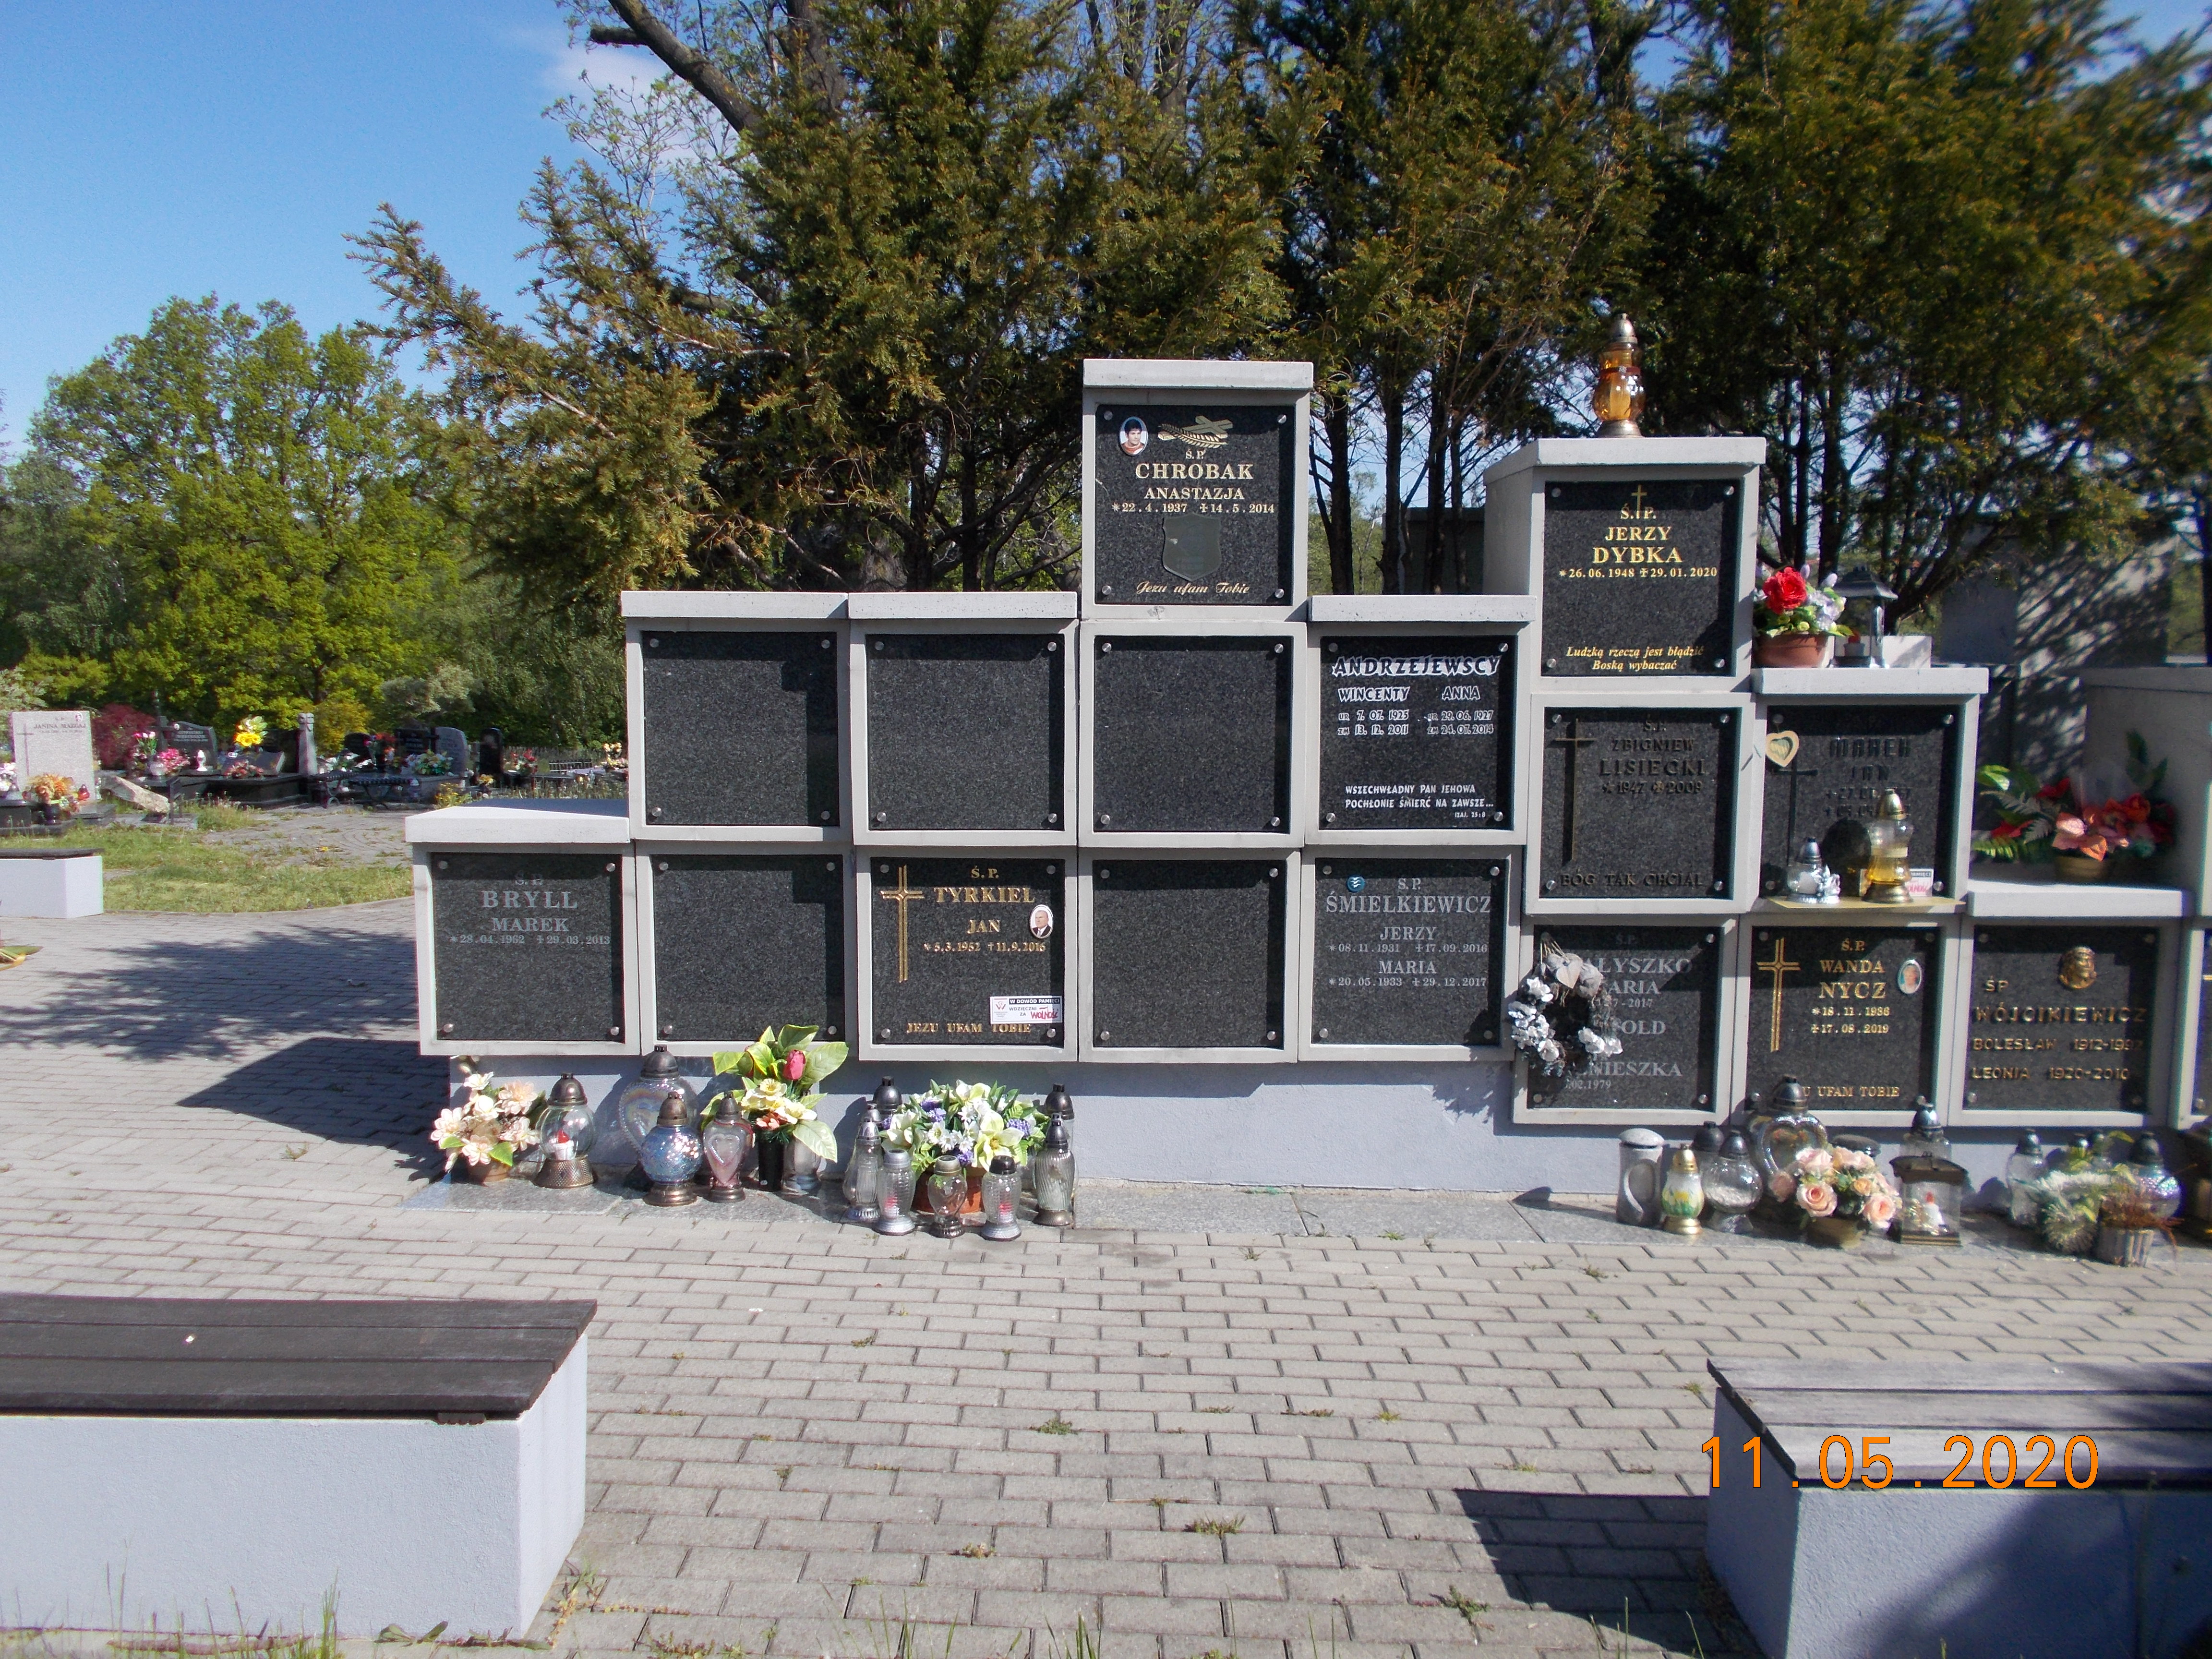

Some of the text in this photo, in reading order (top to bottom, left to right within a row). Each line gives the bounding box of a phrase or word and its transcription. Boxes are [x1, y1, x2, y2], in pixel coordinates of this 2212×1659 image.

[1135, 463, 1254, 480] CHROBAK
[1144, 488, 1244, 500] ANASTAZJA
[1605, 526, 1672, 541] JERZY
[1592, 547, 1683, 564] DYBKA
[1136, 581, 1250, 595] Jezu ufam Tobie
[1566, 646, 1704, 658] Ludzką rzeczą jest błądzić
[1332, 655, 1502, 677] ANDRZEJEWSCY
[1592, 660, 1677, 672] Boską wybaczać
[1337, 686, 1410, 702] WINCENTY
[1442, 685, 1480, 701] ANNA
[1338, 713, 1350, 721] UR
[1427, 713, 1439, 721] UR
[1337, 727, 1349, 735] ZM
[1427, 726, 1439, 734] ZM
[1611, 738, 1695, 752] ZBIGNIEW
[1599, 758, 1706, 777] LISIECKI
[1346, 784, 1476, 794] WSZECHWŁADNY PAN JEHOWA
[1345, 799, 1395, 808] POCHŁONIE
[1399, 796, 1431, 808] ŚMIERĆ
[1436, 799, 1447, 807] NA
[1605, 874, 1636, 887] TAK
[482, 890, 578, 908] BRYLL
[934, 887, 1036, 903] TYRKIEL
[1325, 890, 1491, 913] ŚMIELKIEWICZ
[492, 918, 569, 932] MAREK
[967, 920, 1000, 934] JAN
[1380, 926, 1437, 940] JERZY
[1378, 961, 1438, 974] MARIA
[1820, 960, 1886, 974] WANDA
[1609, 980, 1661, 994] ARIA
[1819, 982, 1887, 999] NYCZ
[906, 1023, 938, 1034] JEZU
[947, 1023, 982, 1033] UFAM
[1973, 1038, 2057, 1051] BOLESŁAW
[1972, 1067, 2031, 1080] LEONIA
[1817, 1086, 1854, 1097] UFAM
[1860, 1086, 1900, 1097] TOBIE
